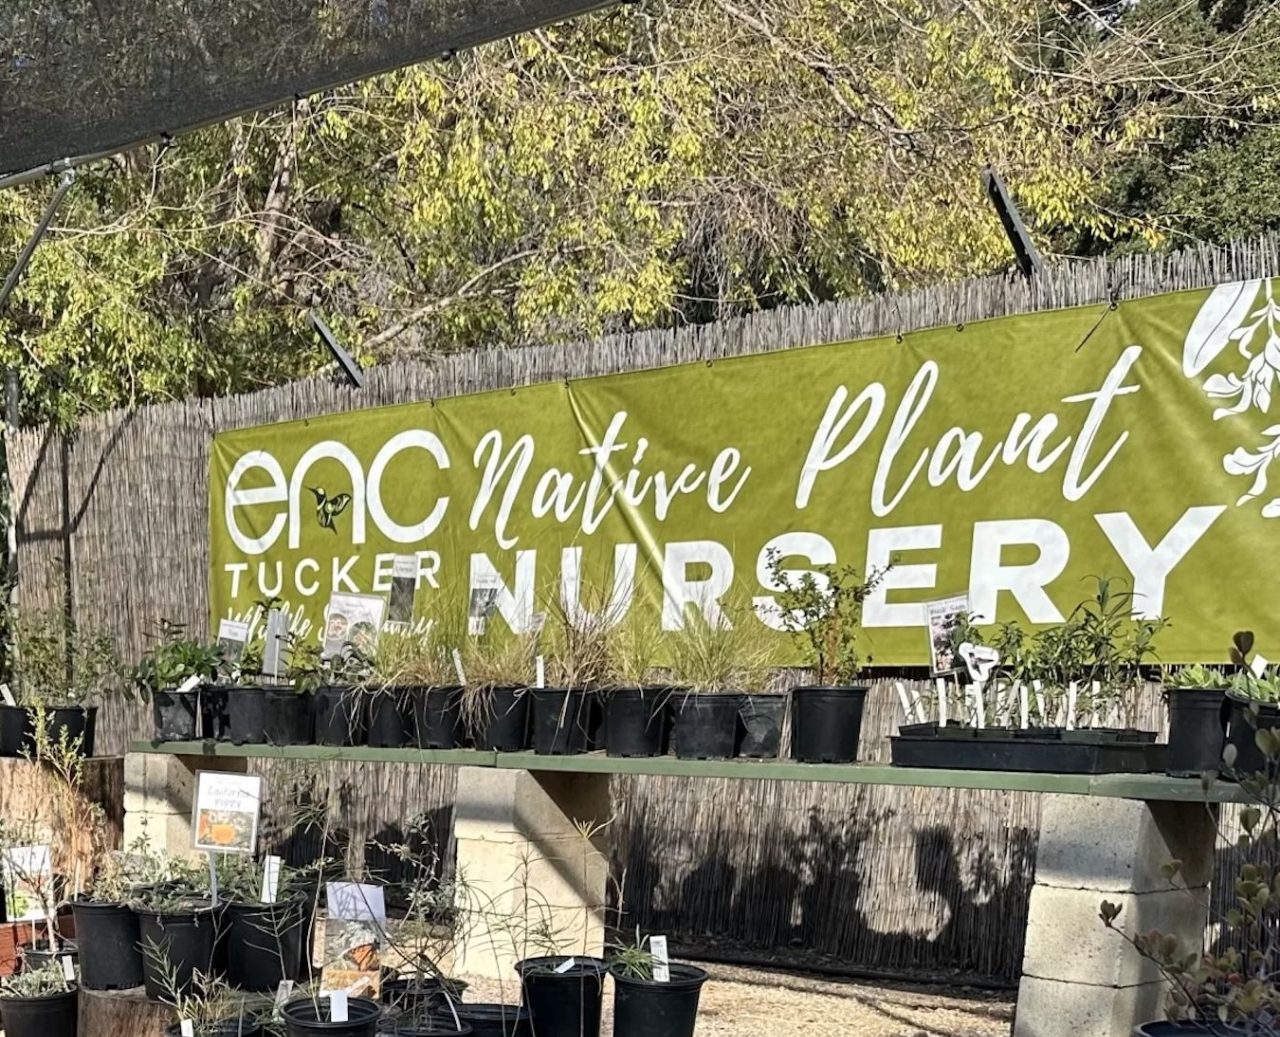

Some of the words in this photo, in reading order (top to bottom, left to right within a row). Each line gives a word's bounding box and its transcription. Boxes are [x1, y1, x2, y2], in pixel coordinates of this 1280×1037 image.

[468, 410, 752, 550] Native
[795, 344, 1142, 518] Plant
[224, 549, 442, 599] TUCKER
[468, 504, 1229, 637] NURSERY
